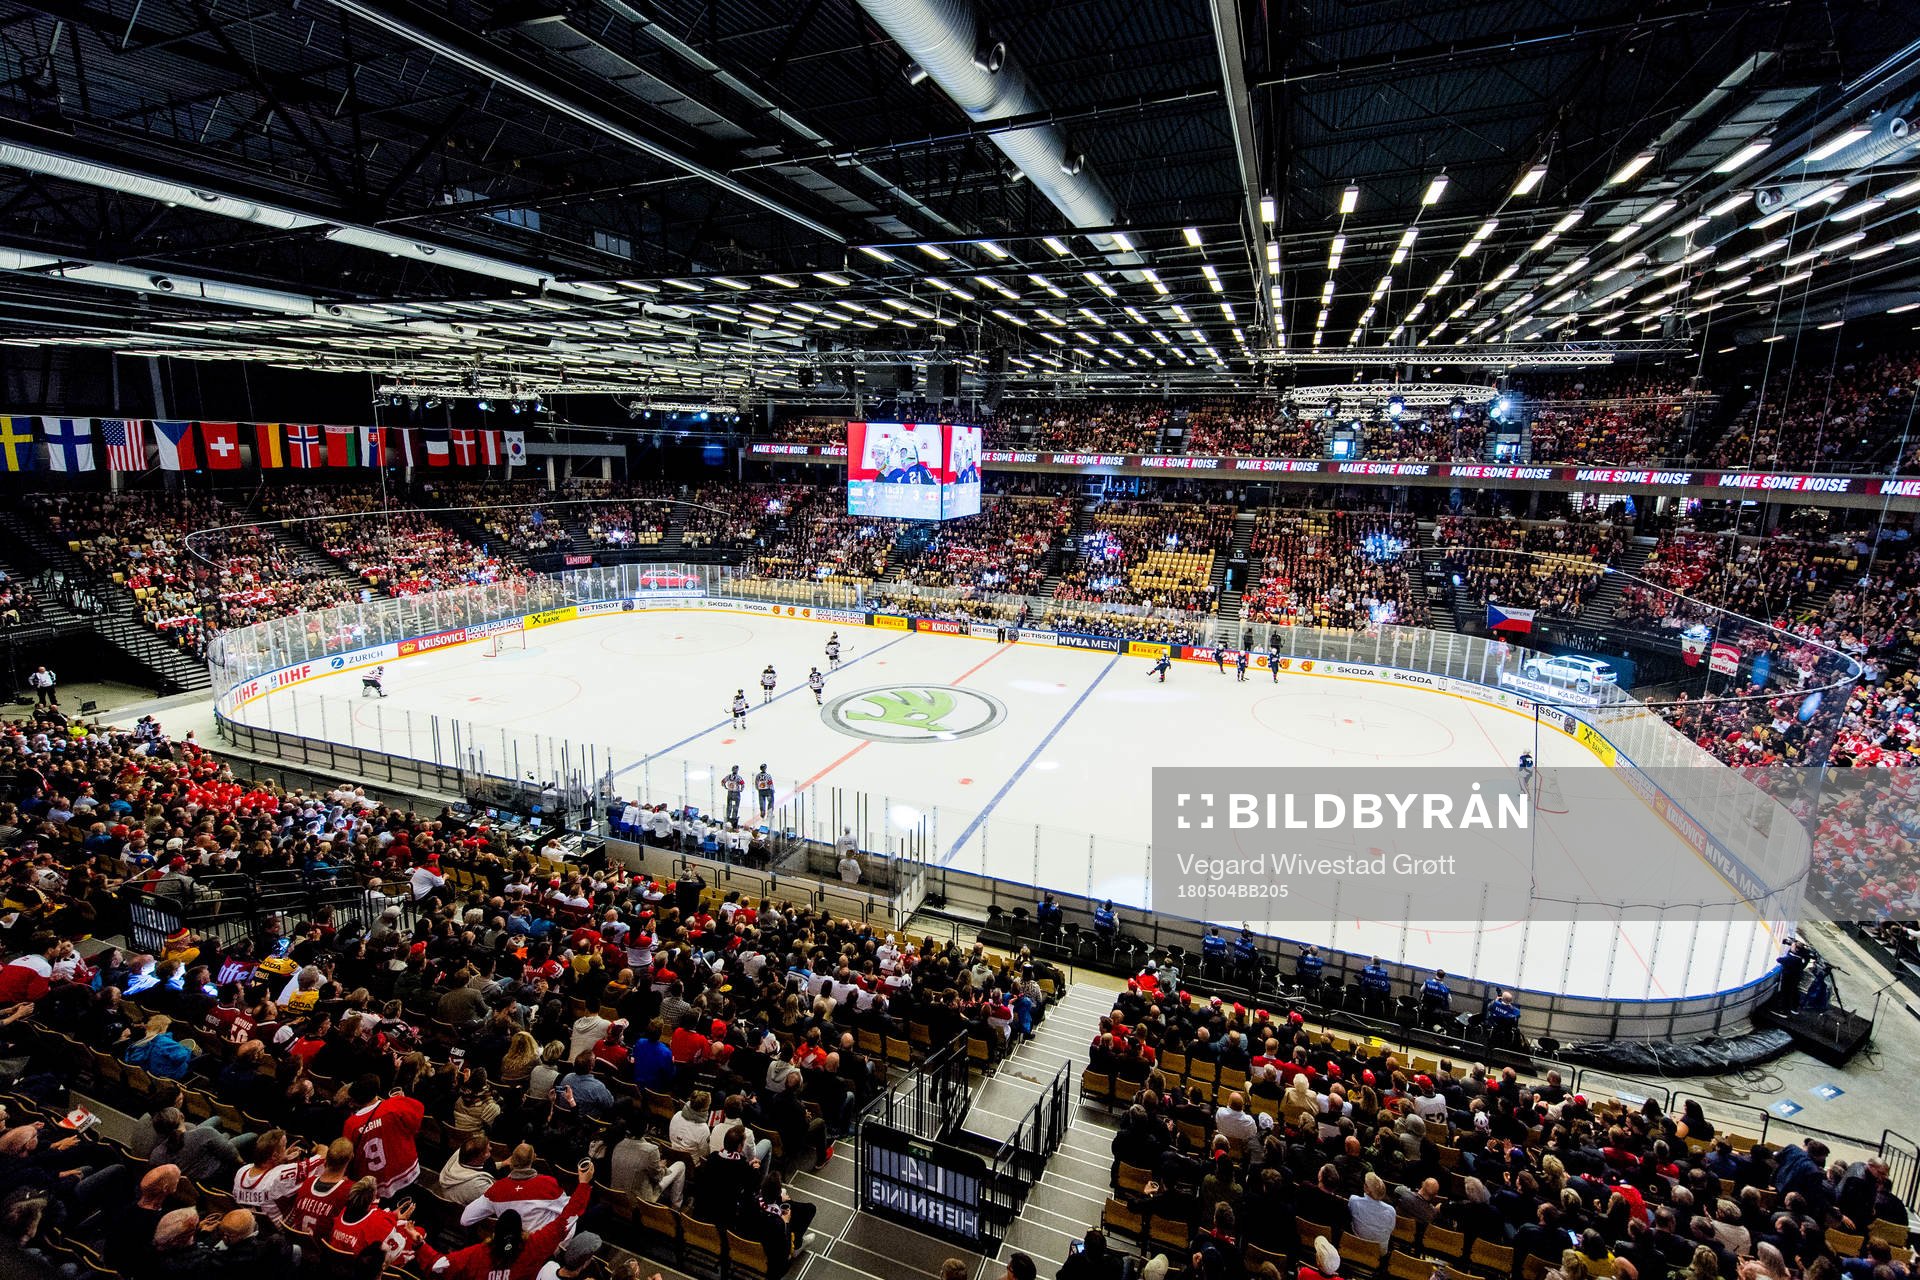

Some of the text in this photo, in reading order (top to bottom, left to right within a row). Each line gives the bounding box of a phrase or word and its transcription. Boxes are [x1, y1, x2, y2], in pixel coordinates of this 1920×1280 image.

[752, 444, 808, 455] MAKE SOME NOISE
[821, 447, 838, 456] MAKE
[981, 452, 1037, 463] KE SOME NOISE
[1053, 455, 1125, 465] MAKE SOME NOISE
[1141, 457, 1218, 468] MAKE SOME NOISE
[1236, 460, 1319, 472] MAKE SOME NOISE
[1338, 463, 1429, 475] MAKE SOME NOISE
[1450, 466, 1552, 480] MAKE SOME NOISE
[1575, 470, 1691, 485] MAKE SOME NOISE
[1719, 474, 1851, 492] MAKE SOME NOISE
[1880, 480, 1920, 496] MAKE
[591, 602, 619, 612] TISSOT
[932, 620, 960, 633] KRUŠOV
[418, 631, 465, 650] KRUŠOVICE
[1031, 632, 1056, 641] TISSOT
[1059, 635, 1118, 650] NIVEA MEN
[348, 650, 384, 665] ZURICH
[278, 665, 311, 686] IIHF
[235, 682, 259, 704] IIHF
[1532, 703, 1563, 722] TSSOT
[1704, 841, 1738, 884] NIVEA
[363, 1137, 387, 1172] 9
